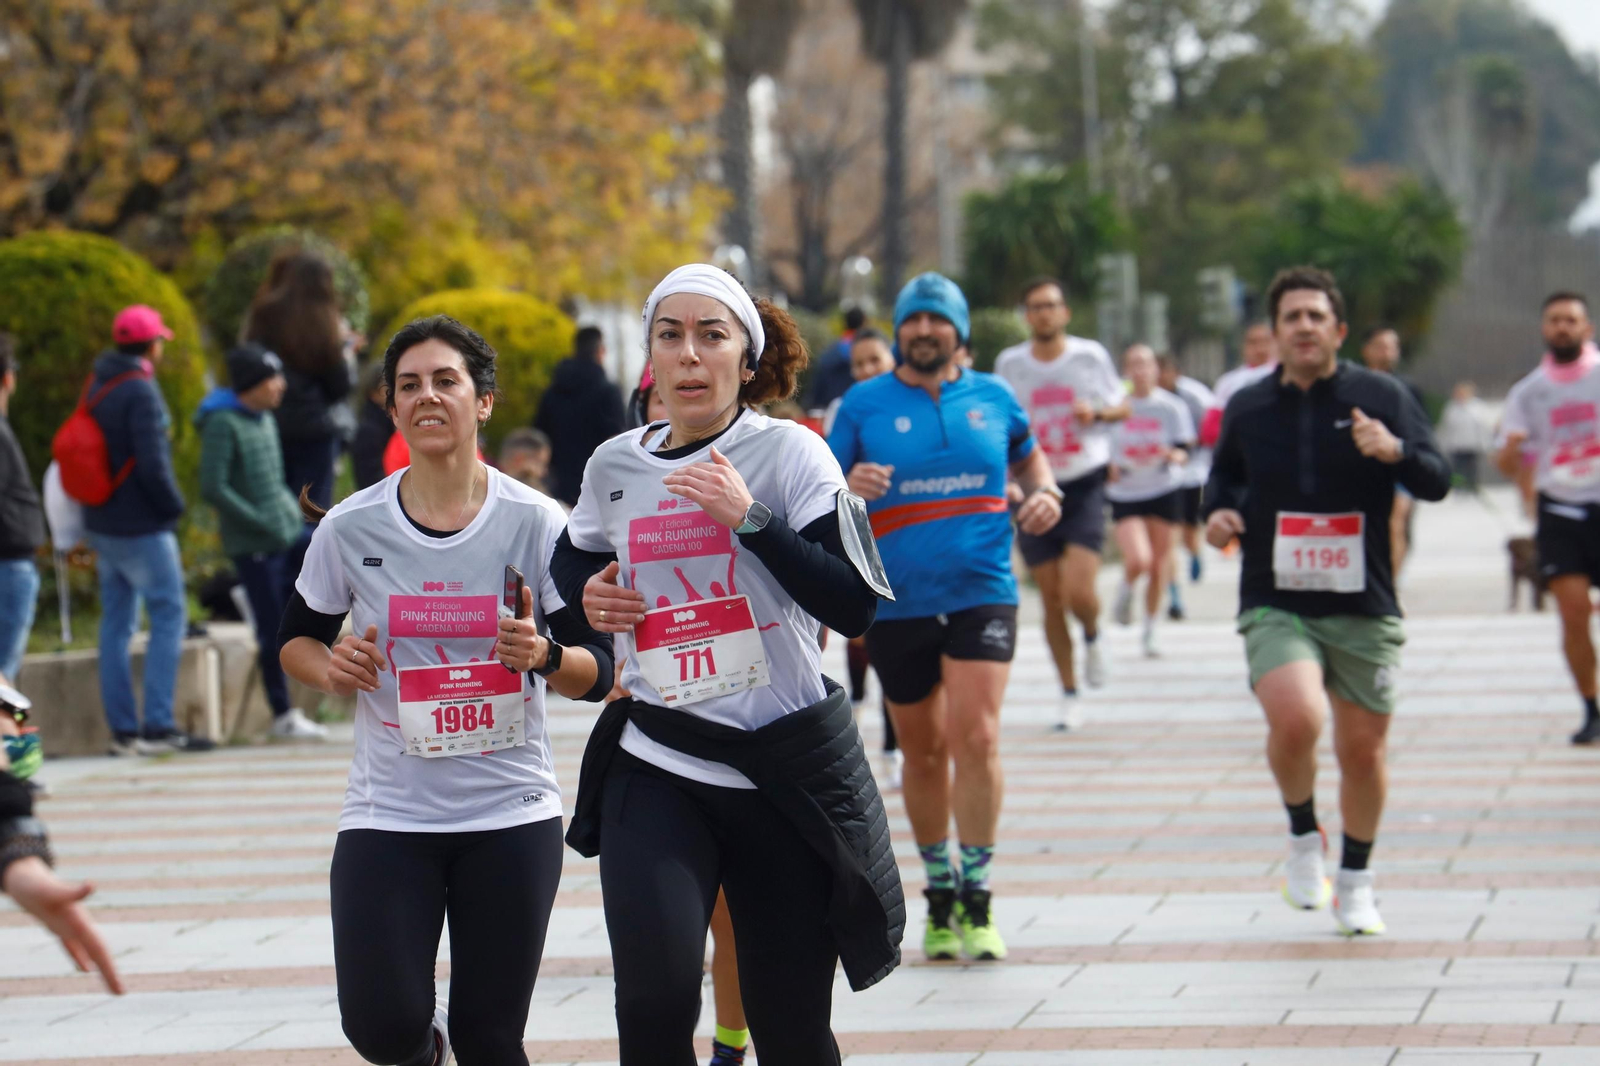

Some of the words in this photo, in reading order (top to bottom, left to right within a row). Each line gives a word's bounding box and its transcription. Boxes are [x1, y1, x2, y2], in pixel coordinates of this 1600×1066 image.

[658, 499, 678, 511] 100
[666, 519, 692, 529] Edición
[637, 532, 662, 544] PINK
[665, 526, 717, 542] RUNNING
[652, 543, 686, 554] CADENA
[688, 542, 702, 551] 100
[1292, 547, 1349, 570] 1196
[423, 581, 445, 592] 100
[433, 602, 461, 610] Edición
[401, 611, 428, 622] PINK
[432, 611, 485, 622] RUNNING
[673, 610, 696, 623] 100
[416, 624, 453, 633] CADENA
[455, 624, 470, 633] 100
[665, 625, 681, 634] PINK
[682, 621, 710, 630] RUNNING
[673, 646, 717, 682] 771
[449, 669, 471, 681] 100
[440, 682, 454, 690] PINK
[431, 703, 495, 734] 1984
